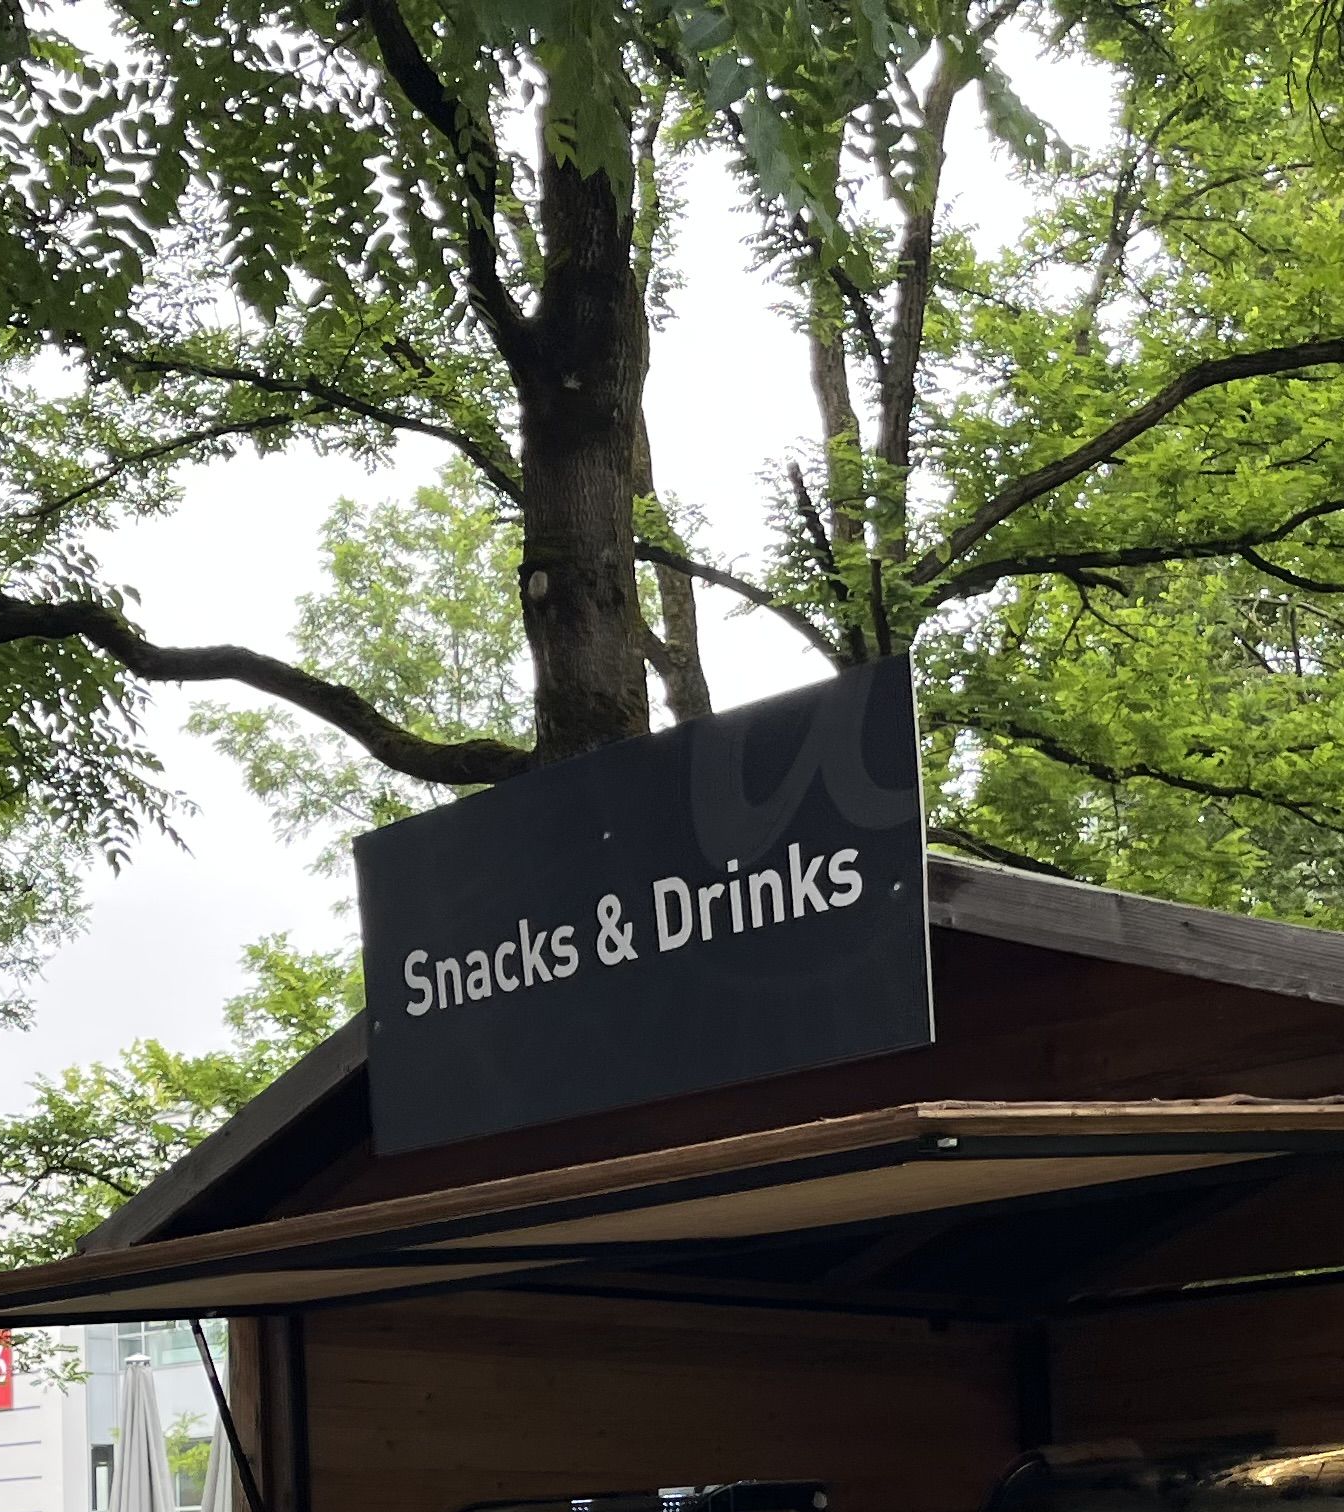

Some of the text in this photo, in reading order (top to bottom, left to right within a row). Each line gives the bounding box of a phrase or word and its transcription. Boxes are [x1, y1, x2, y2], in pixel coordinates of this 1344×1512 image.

[403, 842, 864, 1017] Snacks & Drinks
